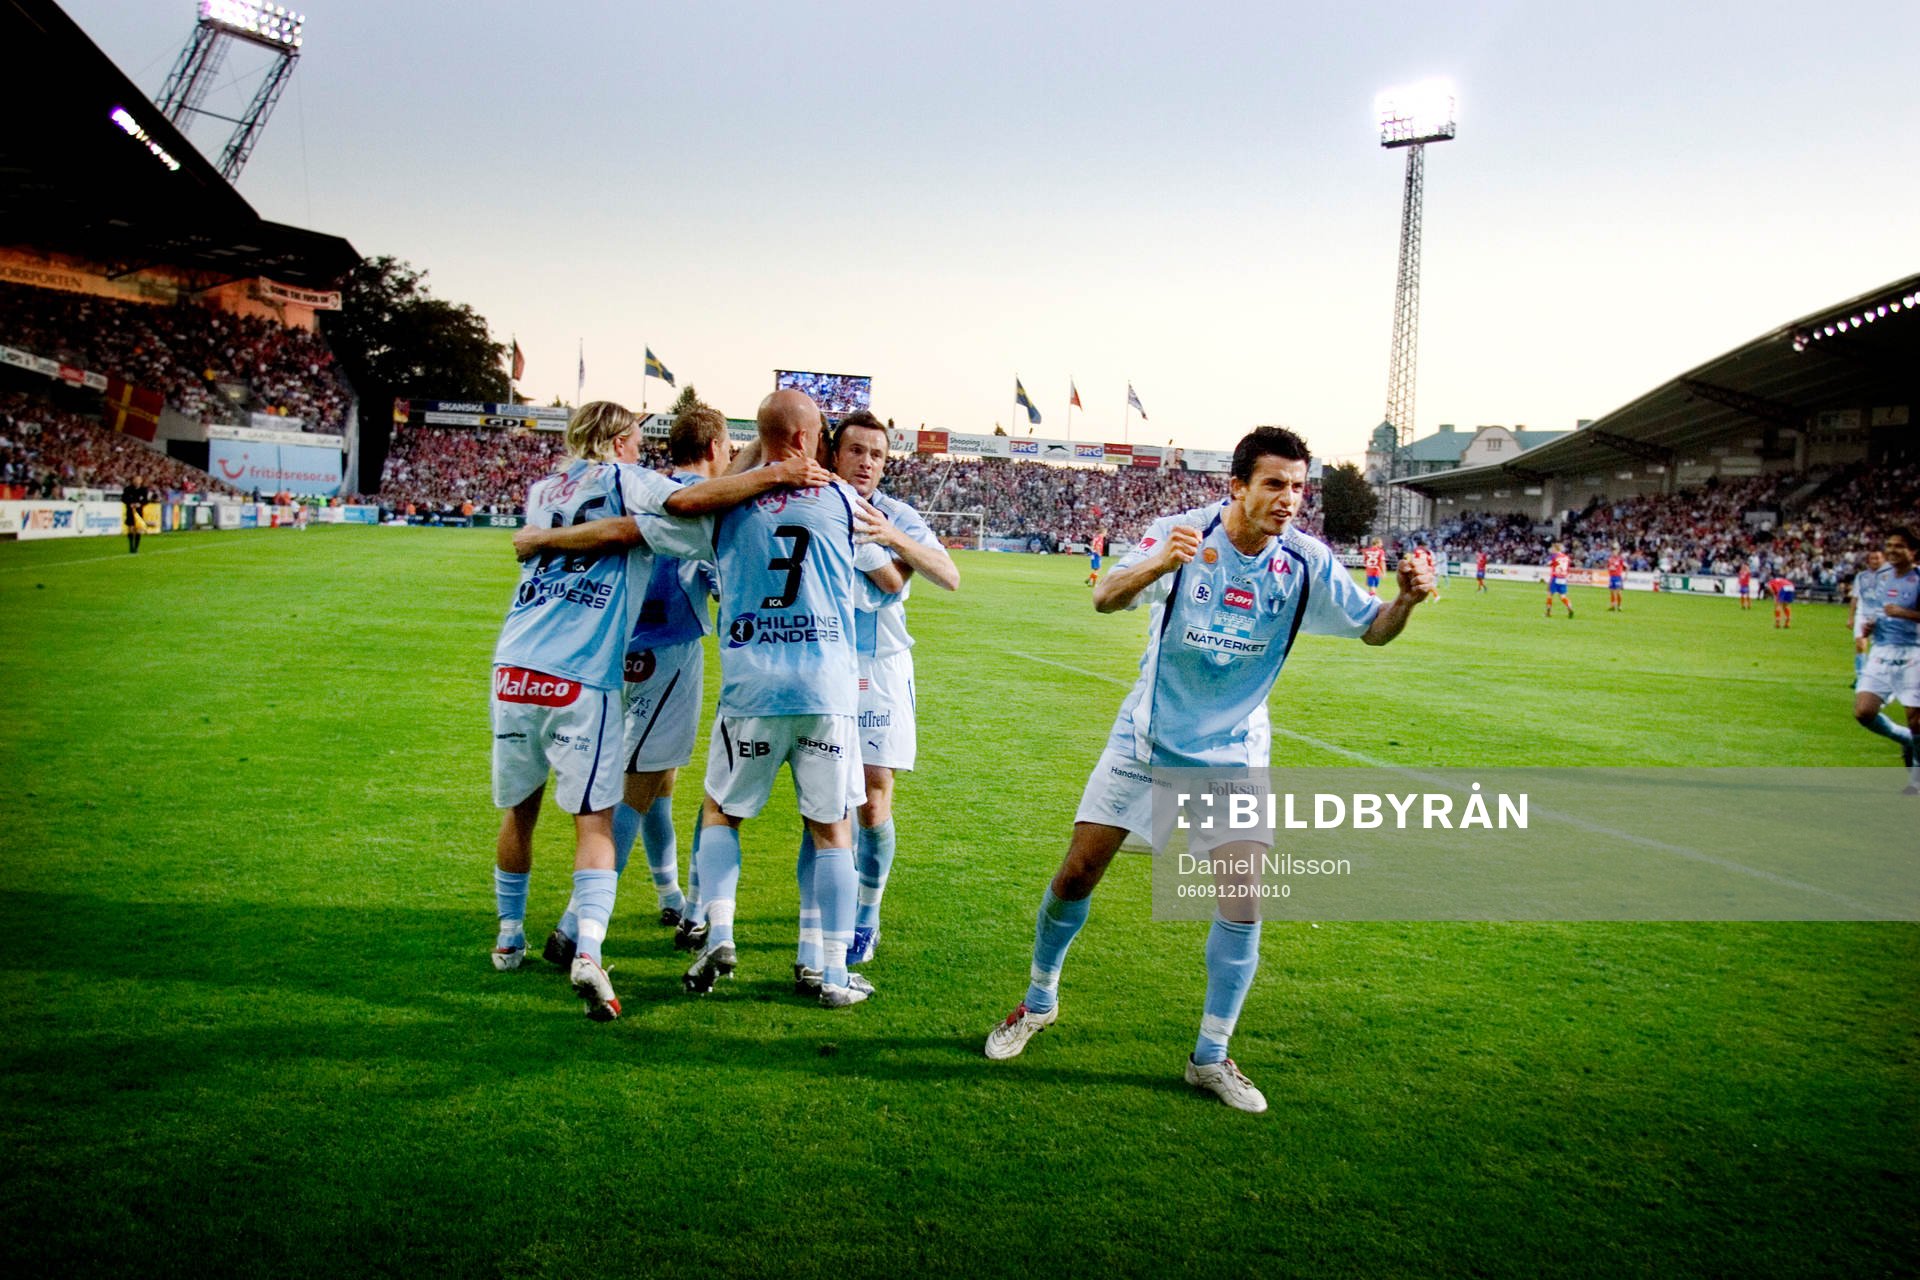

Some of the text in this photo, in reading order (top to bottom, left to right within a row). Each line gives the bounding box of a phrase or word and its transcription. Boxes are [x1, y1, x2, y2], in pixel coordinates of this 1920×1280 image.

[438, 402, 485, 413] SKANSKA
[949, 437, 981, 447] Shopping
[1010, 442, 1038, 453] PRG
[1075, 446, 1103, 457] PRG
[249, 466, 337, 481] fritidsresor.se
[490, 516, 518, 527] SEB
[761, 525, 810, 609] 3
[1268, 557, 1292, 575] ICA
[768, 599, 783, 607] ICA
[757, 614, 838, 630] HILDING
[757, 629, 839, 644] ANDERS
[497, 671, 570, 697] Malaco
[858, 709, 891, 728] rdTrend
[1111, 766, 1172, 789] Handelsbanken
[1208, 781, 1267, 797] Folksam
